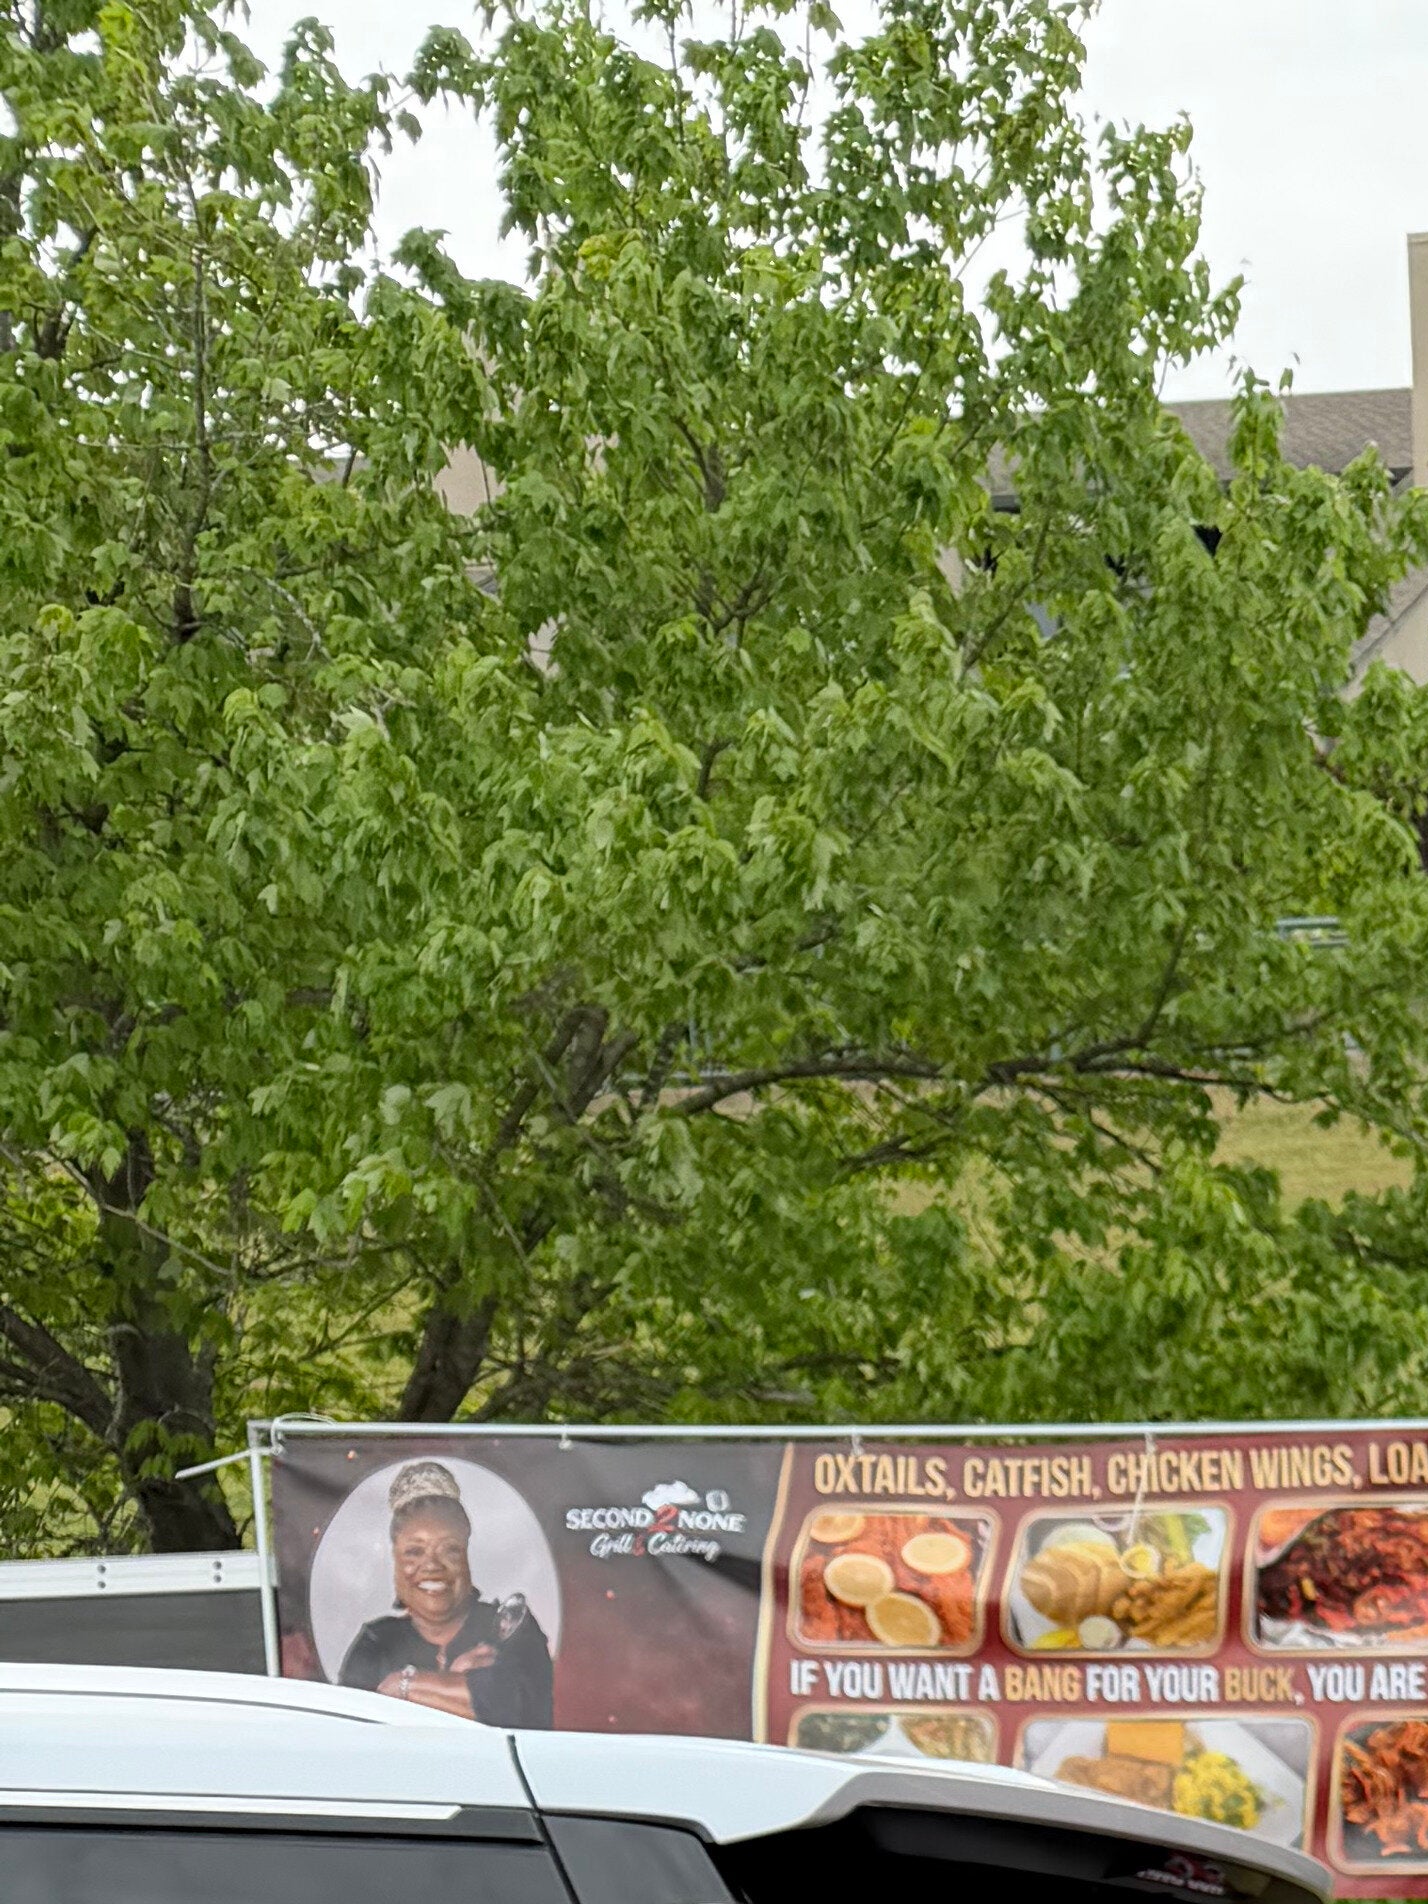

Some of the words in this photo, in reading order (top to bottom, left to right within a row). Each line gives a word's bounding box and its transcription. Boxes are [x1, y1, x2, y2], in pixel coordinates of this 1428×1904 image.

[814, 1452, 956, 1501] OXTAILS,
[962, 1455, 1101, 1500] CATFISH,
[1107, 1449, 1244, 1495] CHICKEN
[1248, 1443, 1363, 1490] WINGS,
[565, 1506, 655, 1531] SECOND
[647, 1503, 679, 1533] 2
[677, 1510, 747, 1534] NONE
[589, 1532, 634, 1559] Grill
[647, 1530, 722, 1562] Catering
[789, 1658, 820, 1696] IF
[823, 1660, 883, 1699] YOU
[887, 1661, 975, 1700] WANT
[977, 1662, 1000, 1701] A
[1003, 1663, 1082, 1702] BANG
[1085, 1662, 1142, 1702] FOR
[1144, 1662, 1221, 1702] YOUR
[1223, 1663, 1305, 1706] BUCK,
[1306, 1661, 1366, 1702] YOU
[1369, 1661, 1428, 1701] ARE
